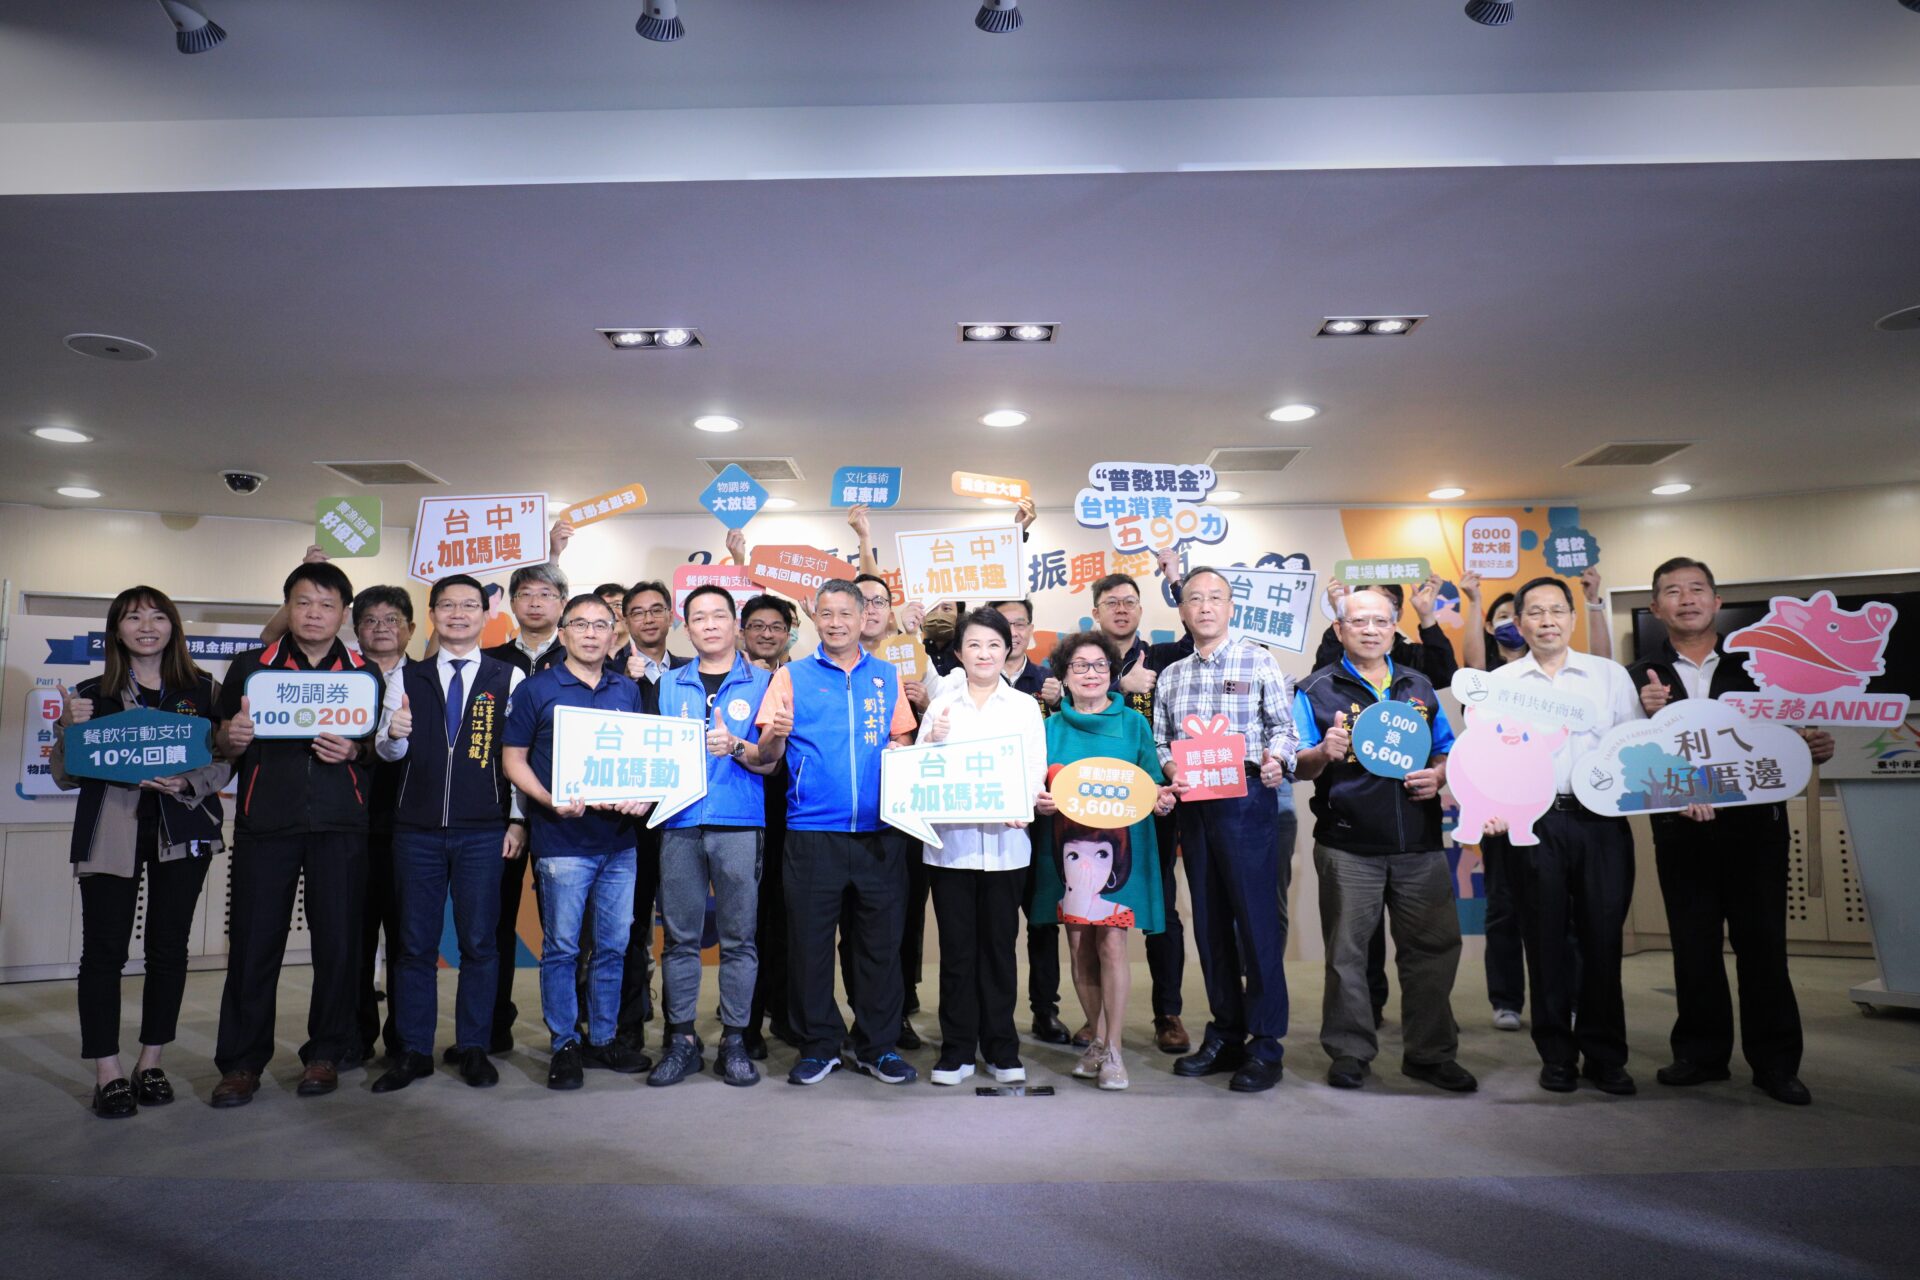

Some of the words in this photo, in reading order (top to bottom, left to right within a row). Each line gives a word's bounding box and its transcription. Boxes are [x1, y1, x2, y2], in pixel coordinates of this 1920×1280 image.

[717, 481, 750, 493] 物調券
[845, 472, 889, 484] 文化藝術
[712, 496, 757, 511] 大放送
[843, 486, 888, 503] 優惠購
[1080, 496, 1173, 519] 台中消費
[320, 511, 366, 554] 好優惠
[1472, 528, 1511, 539] 6000
[438, 533, 522, 567] 加碼喫
[1471, 542, 1511, 554] 放大術
[779, 551, 828, 572] 行動支付
[1556, 552, 1588, 568] 加碼
[927, 564, 1007, 593] 加碼趣
[36, 677, 54, 685] Part
[276, 682, 348, 704] 物調券
[252, 711, 290, 725] 100
[318, 708, 367, 726] 200
[1380, 711, 1418, 733] 6,000
[83, 723, 192, 745] 餐飲行動支付
[1384, 729, 1401, 747] 換
[90, 745, 187, 766] 10%回饋
[1186, 747, 1233, 766] 聽音樂
[1361, 740, 1413, 770] 6,600
[582, 755, 680, 788] 加碼動
[1184, 766, 1239, 788] 享抽獎
[1664, 757, 1786, 799] 好厝邊
[910, 782, 1005, 812] 加碼玩
[1080, 784, 1127, 796] 最高優惠
[1067, 798, 1137, 818] 3,600元
